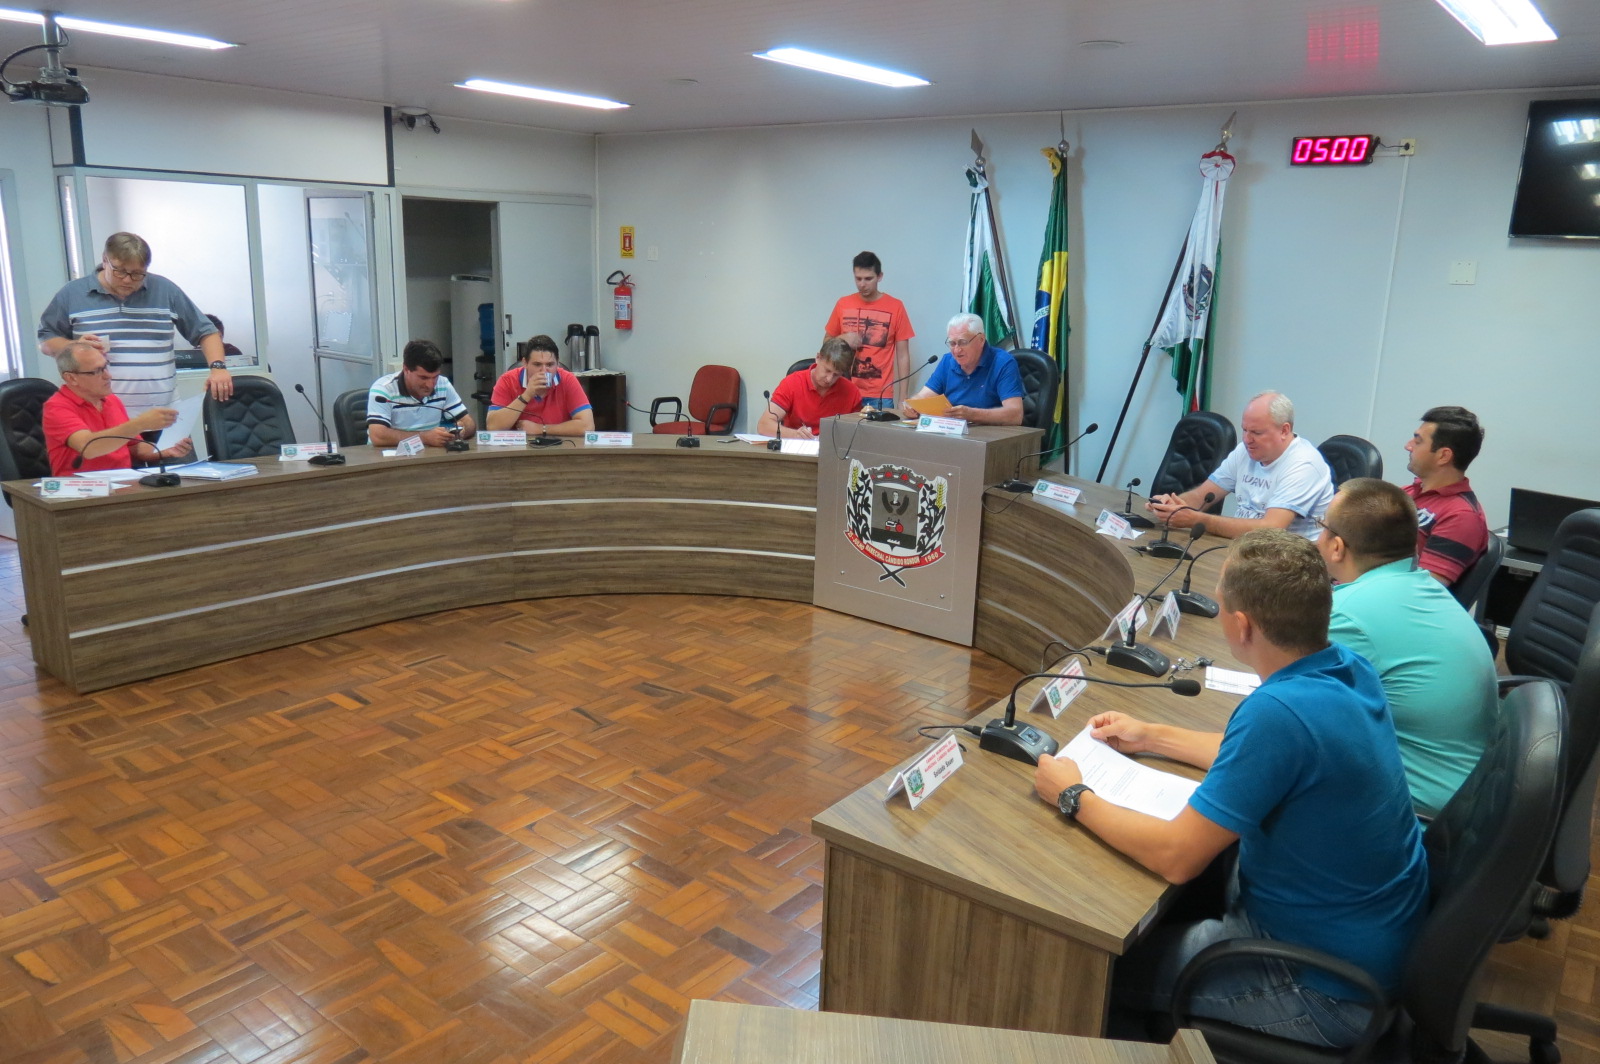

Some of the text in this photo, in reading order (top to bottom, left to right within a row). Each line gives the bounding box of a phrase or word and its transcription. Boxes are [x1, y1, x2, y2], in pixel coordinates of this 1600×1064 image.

[1293, 137, 1369, 163] 0500
[852, 537, 865, 551] JULHO
[865, 543, 920, 566] MARECHAL CÂNDIDO RONDON
